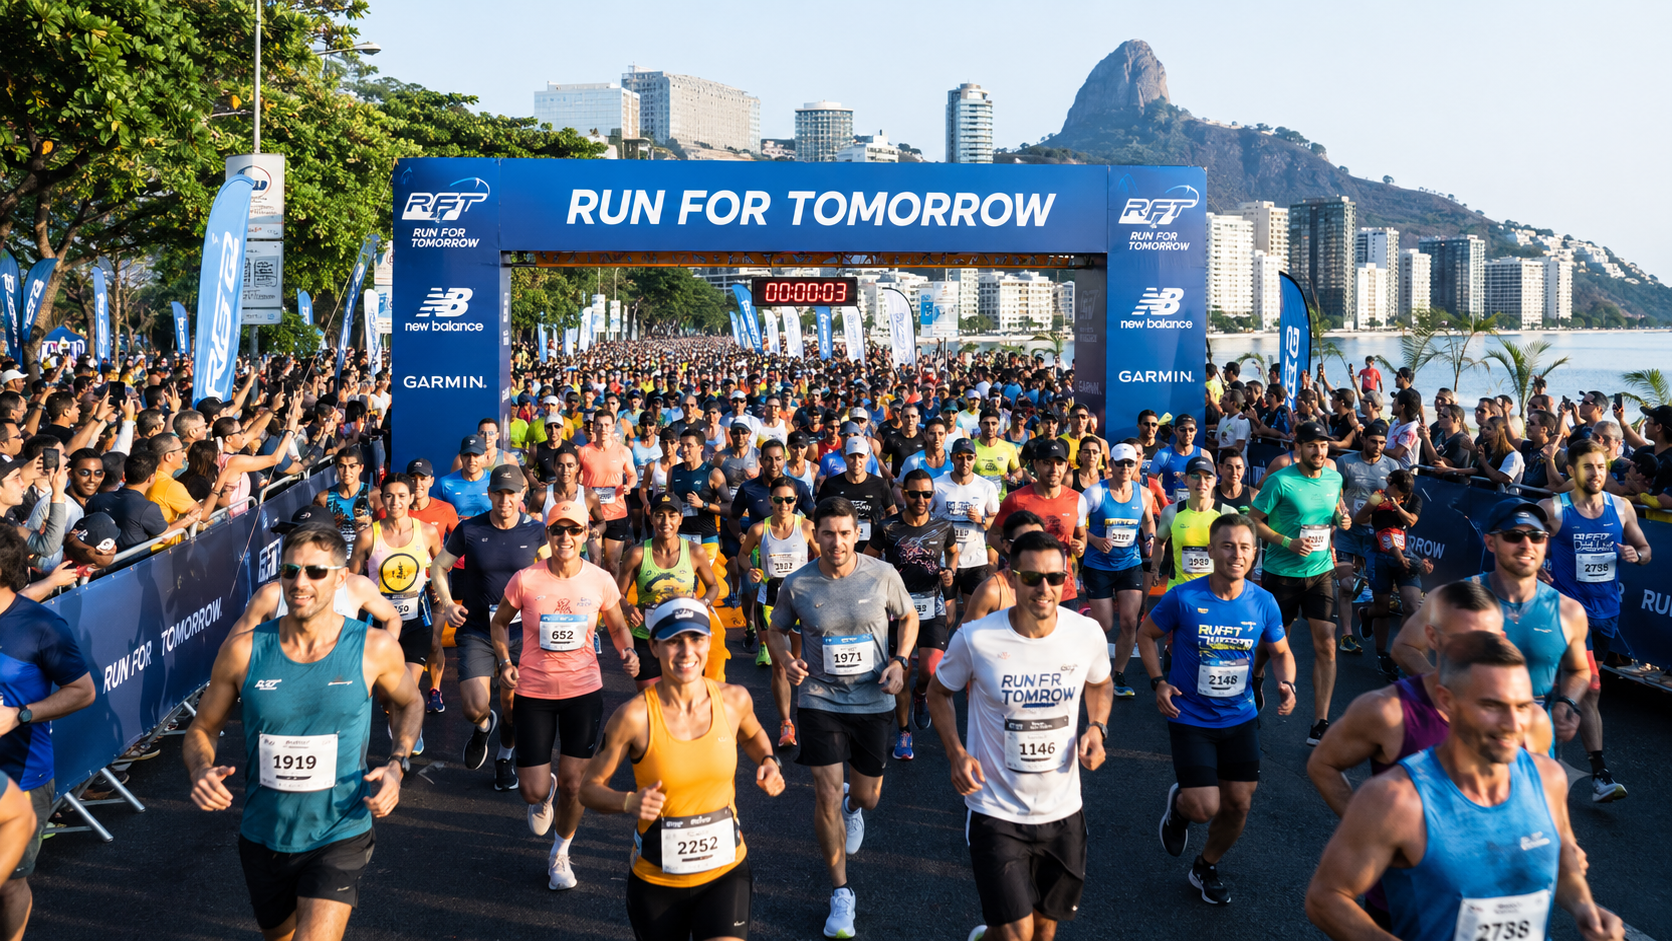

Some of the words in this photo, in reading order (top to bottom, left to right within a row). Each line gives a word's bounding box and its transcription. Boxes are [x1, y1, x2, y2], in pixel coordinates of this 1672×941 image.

[566, 189, 666, 226] RUN
[677, 190, 771, 226] FOR
[787, 190, 1057, 228] TOMORROW
[412, 227, 439, 238] RUN
[440, 227, 467, 238] FOR
[1130, 231, 1154, 241] RUN
[1155, 231, 1178, 241] FOR
[411, 238, 480, 248] TOMORROW
[1128, 241, 1190, 251] TOMORROW
[764, 282, 848, 302] 00:00:03
[404, 322, 430, 332] new
[431, 320, 484, 332] balance
[1120, 319, 1145, 329] new
[1146, 318, 1193, 329] balance
[1641, 588, 1672, 617] RU
[551, 630, 574, 640] 652
[834, 652, 862, 663] 1971
[103, 654, 130, 694] RUN
[131, 640, 152, 676] FOR
[1001, 674, 1036, 688] RUN
[1019, 742, 1056, 756] 1146
[273, 754, 317, 770] 1919
[677, 836, 718, 855] 2252
